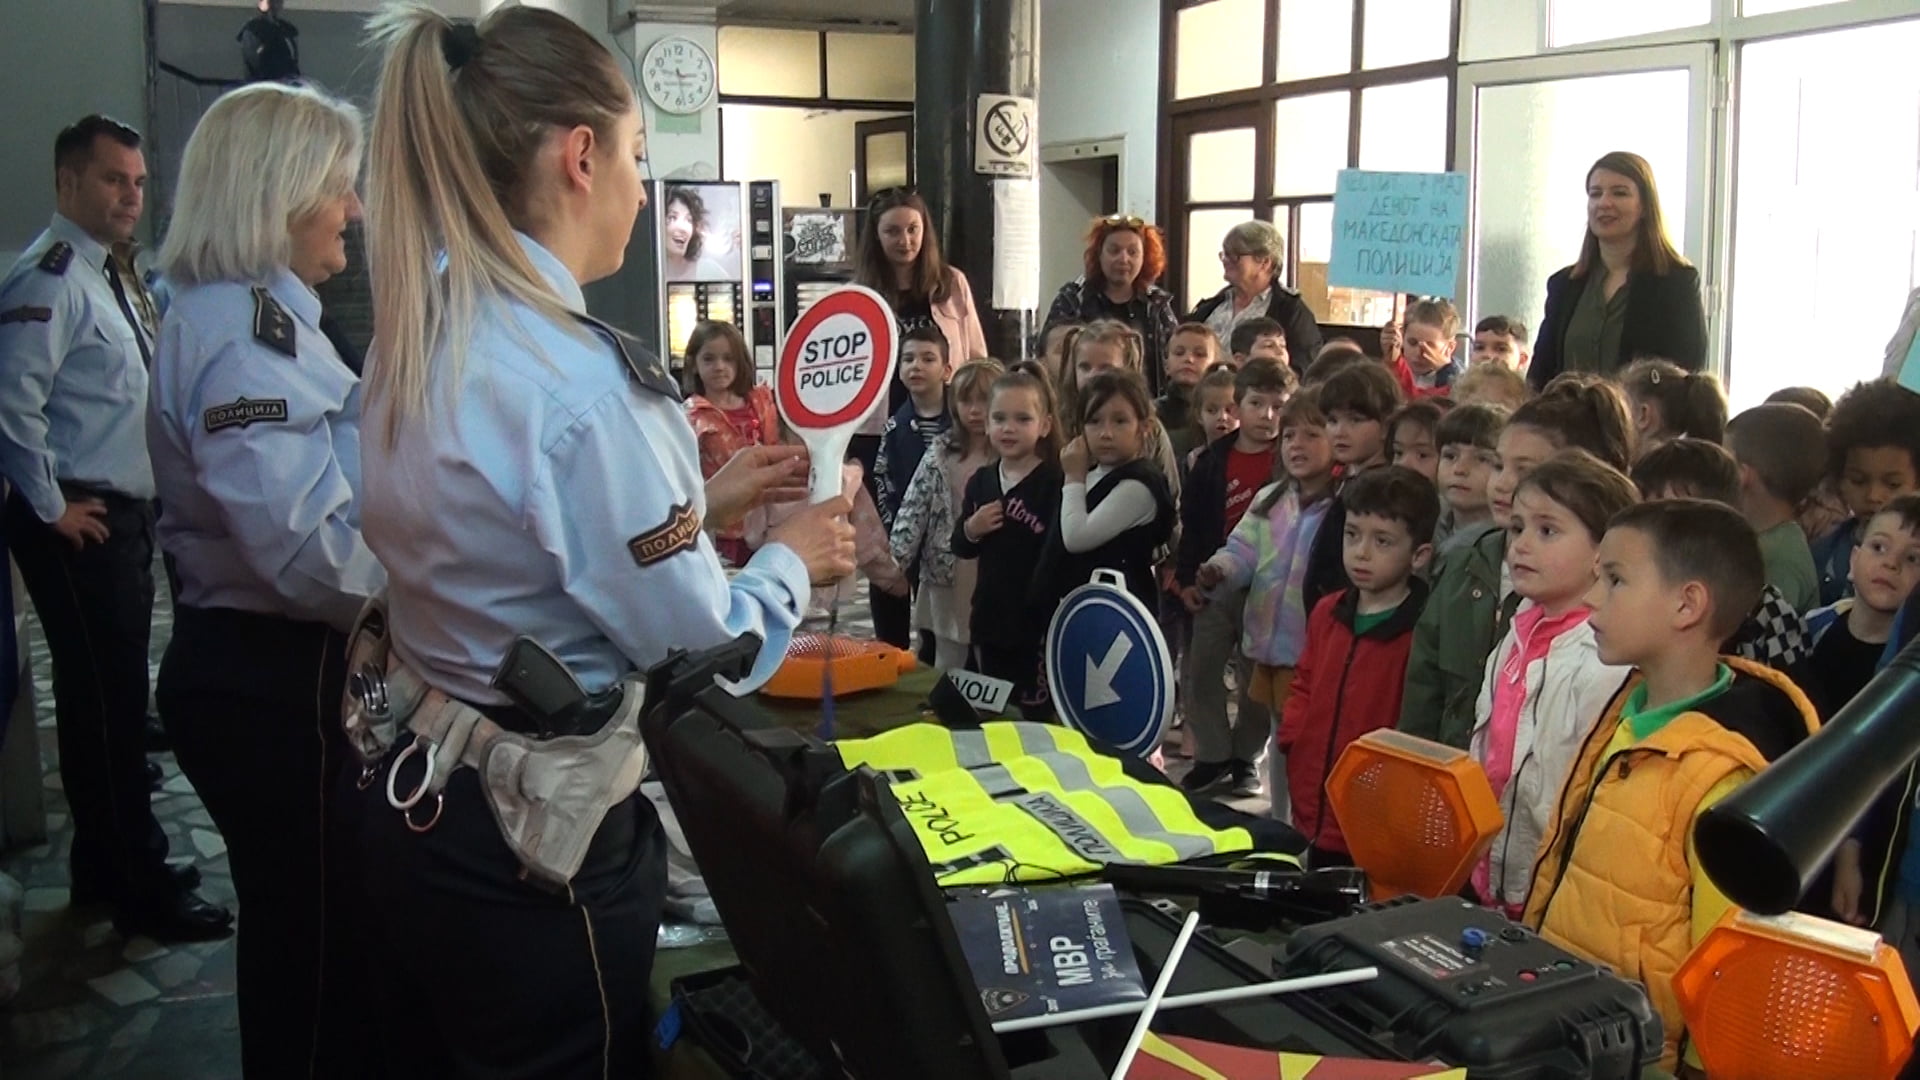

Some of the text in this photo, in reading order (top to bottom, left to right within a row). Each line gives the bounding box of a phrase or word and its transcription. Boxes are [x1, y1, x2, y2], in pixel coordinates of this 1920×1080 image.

[663, 47, 672, 57] 11
[674, 45, 684, 56] 12
[655, 57, 665, 68] 10
[696, 59, 704, 69] 2
[649, 68, 656, 78] 9
[654, 82, 661, 92] 8
[663, 91, 671, 102] 7
[675, 96, 683, 106] 6
[688, 93, 695, 104] 5
[1343, 221, 1462, 247] МАКЕДОНСКАТА
[1357, 249, 1452, 276] ПОЛИЦИЈА
[804, 331, 867, 364] STOP
[800, 363, 865, 390] POLICE
[209, 404, 279, 423] ПОЛИЦИЈА
[641, 518, 696, 557] ПОЛИЦ
[950, 676, 1000, 705] ПОЛ
[1050, 936, 1094, 987] МВР
